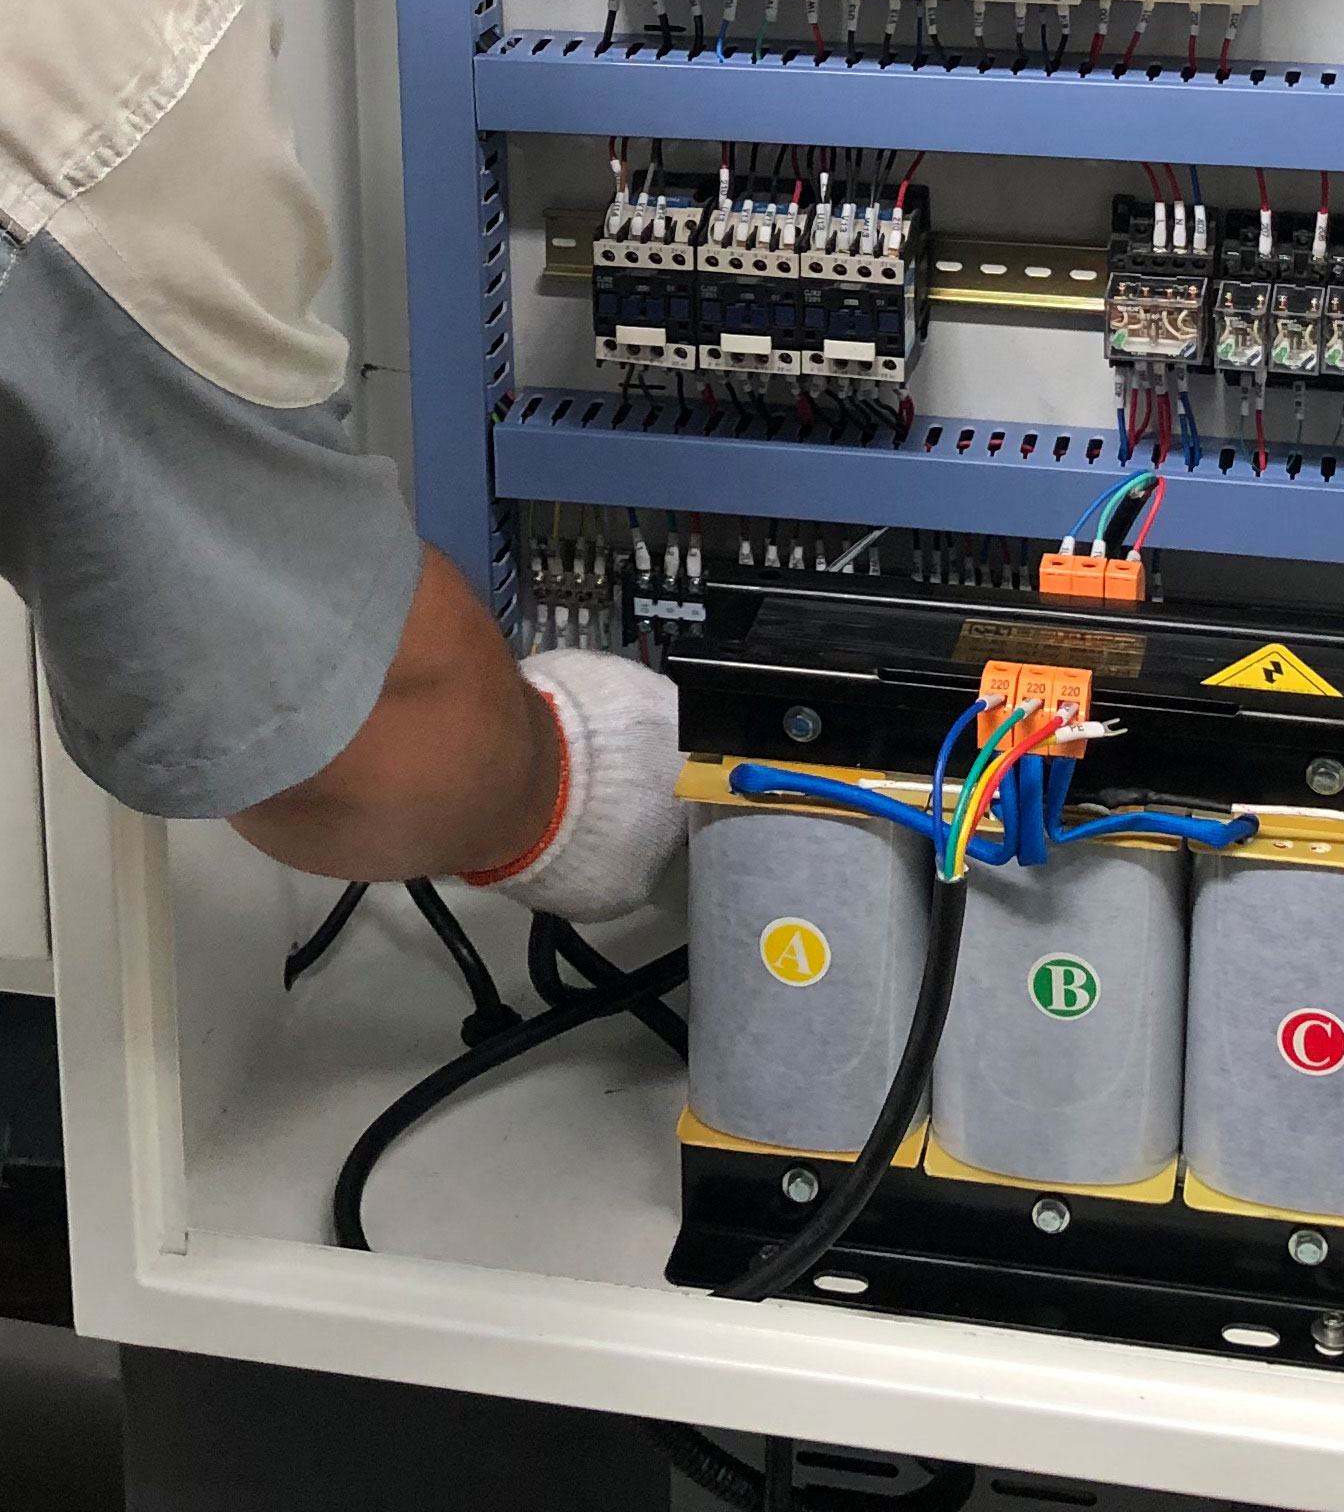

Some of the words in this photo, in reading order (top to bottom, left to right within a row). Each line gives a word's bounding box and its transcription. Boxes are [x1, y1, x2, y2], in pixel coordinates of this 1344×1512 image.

[991, 679, 1010, 690] 220
[1027, 682, 1046, 694] 220
[1061, 685, 1080, 697] 220
[773, 931, 812, 976] A
[1045, 965, 1092, 1012] B
[1292, 1019, 1334, 1066] C
